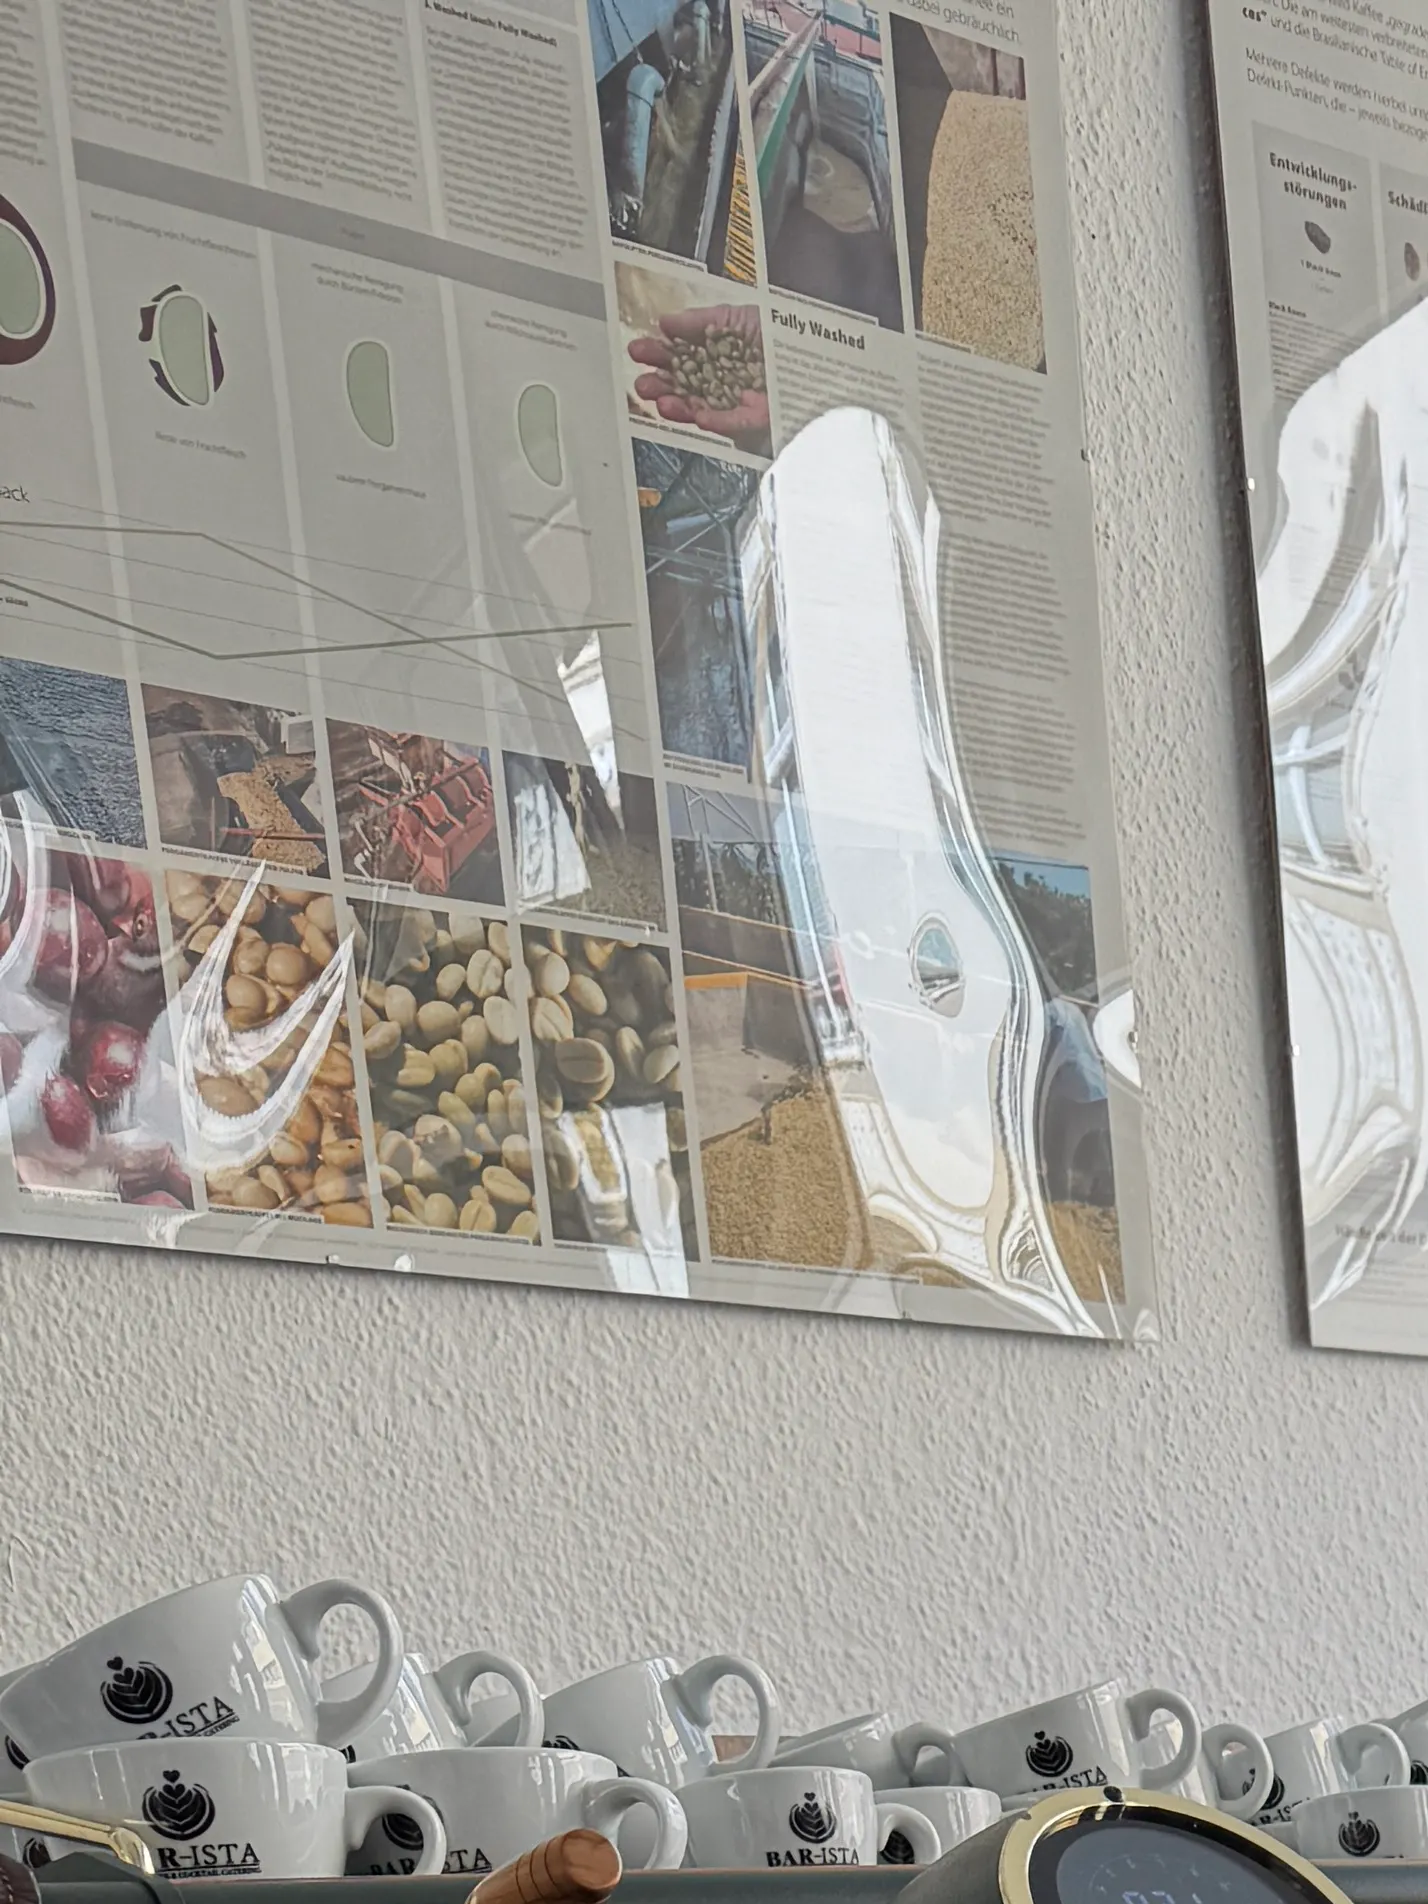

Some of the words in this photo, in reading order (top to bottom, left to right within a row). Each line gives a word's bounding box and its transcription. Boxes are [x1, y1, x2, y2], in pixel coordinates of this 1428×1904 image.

[1268, 152, 1357, 192] Entwicklungs-
[1283, 181, 1347, 211] störungen
[771, 308, 806, 335] Fully
[808, 319, 866, 350] Washed
[766, 1846, 860, 1868] BAR-ISTA
